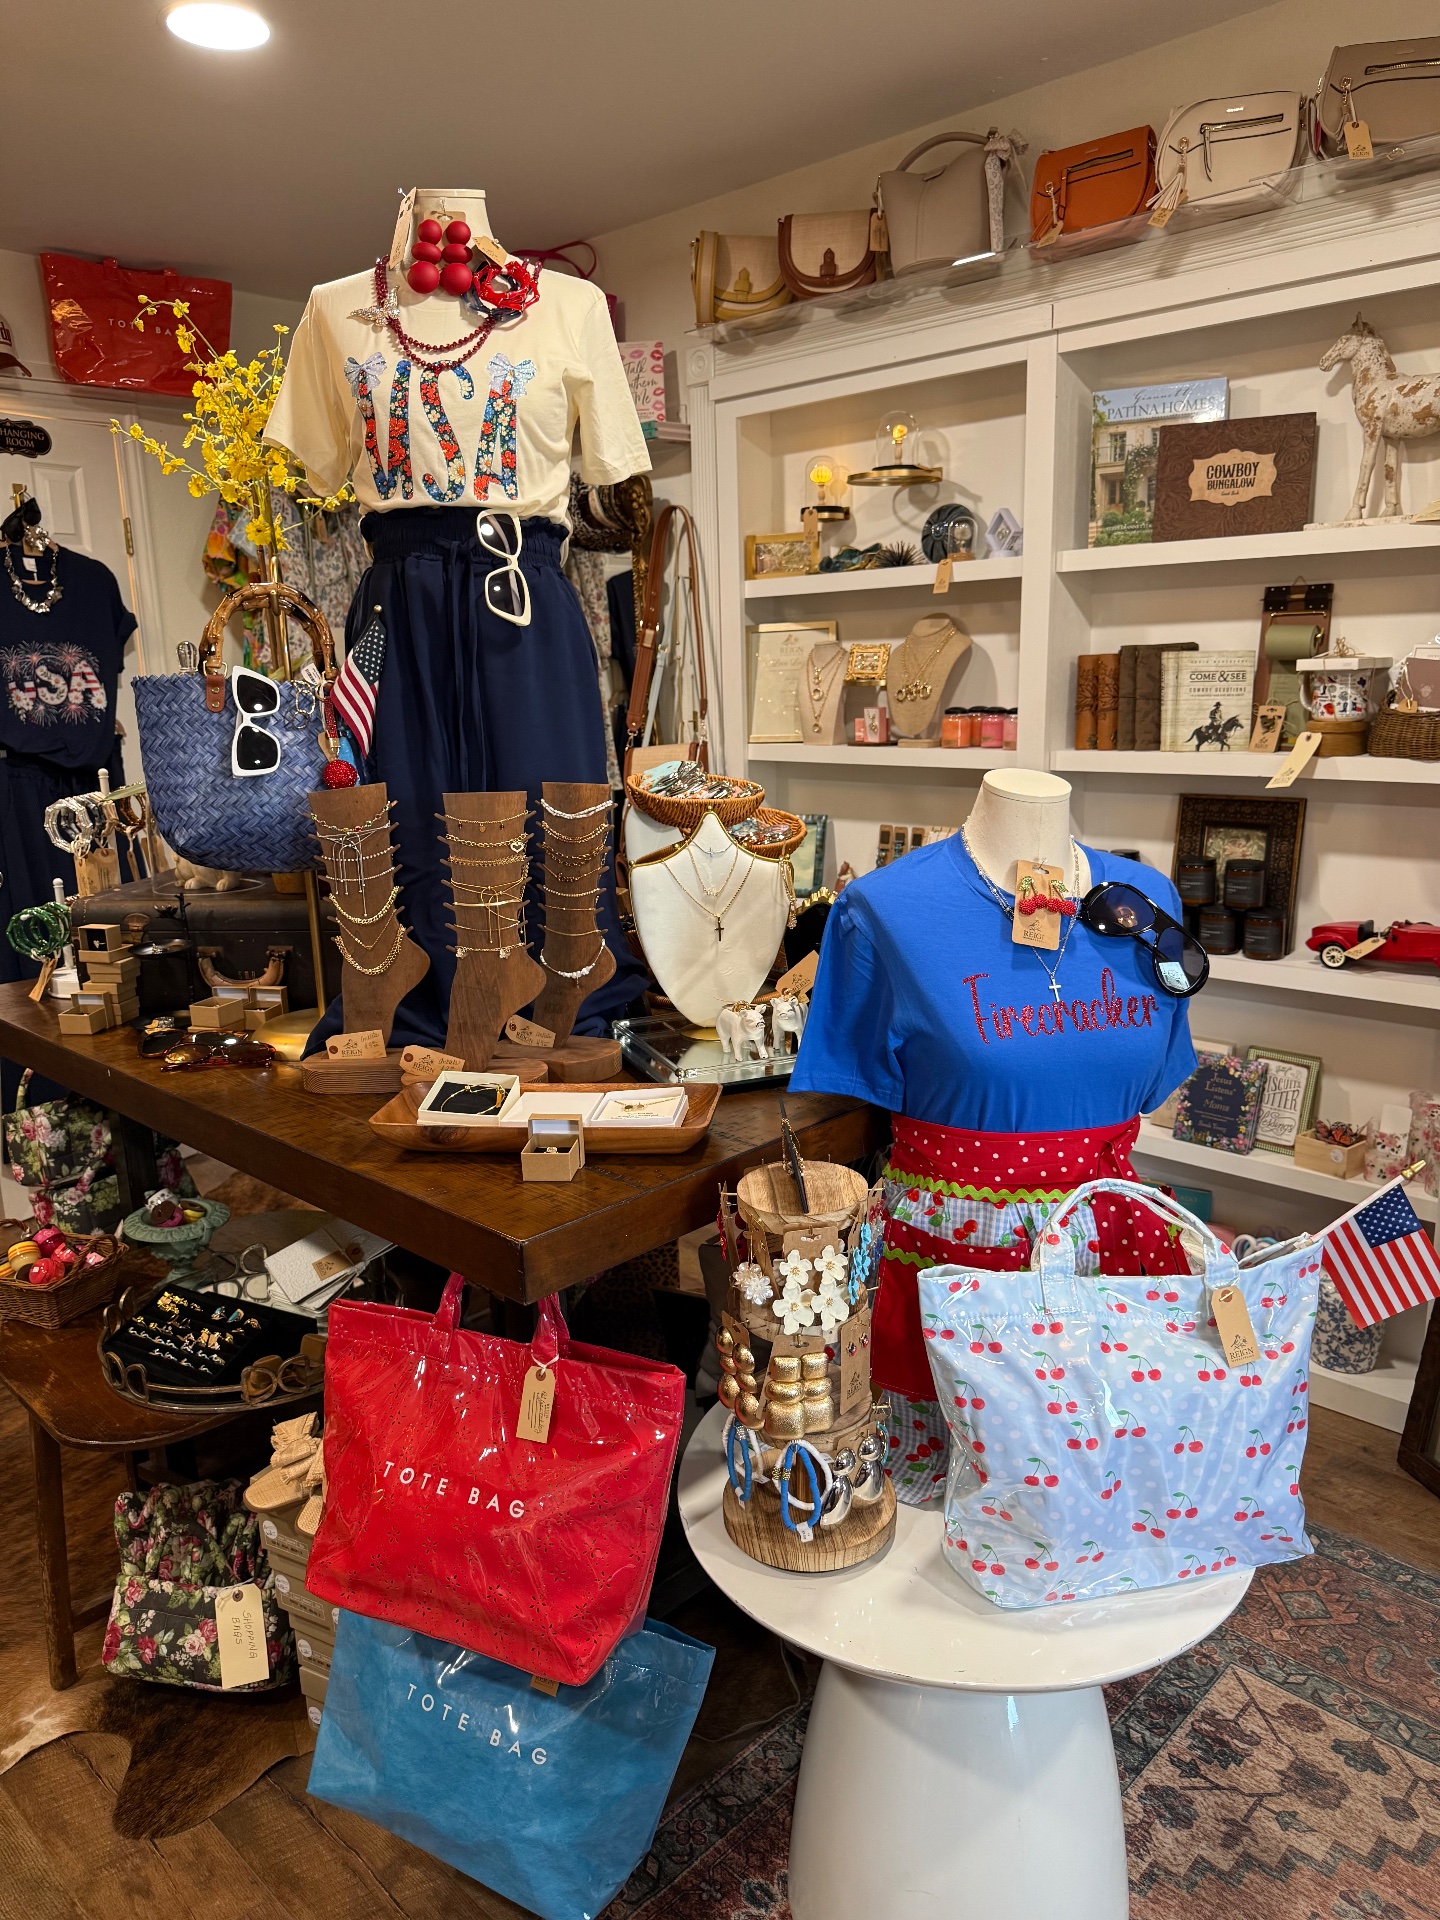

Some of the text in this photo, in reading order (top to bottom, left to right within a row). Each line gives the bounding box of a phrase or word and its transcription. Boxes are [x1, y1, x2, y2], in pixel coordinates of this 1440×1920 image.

[108, 318, 173, 336] TOT BA
[1107, 402, 1159, 420] PATINA
[0, 428, 45, 441] HANGING
[350, 357, 524, 503] USA
[5, 437, 35, 448] ROOM
[1206, 461, 1260, 480] COWBOY
[1207, 477, 1256, 491] BUNGALOW
[7, 659, 108, 712] USA
[1189, 670, 1247, 683] COME & SEE
[962, 967, 1160, 1046] Firecracker
[341, 1048, 363, 1056] REIGN
[413, 1062, 436, 1074] REIGN
[1211, 1072, 1233, 1085] Jesus
[1266, 1074, 1302, 1093] ISCUITS
[1203, 1098, 1230, 1112] Moms
[1263, 1088, 1300, 1112] UTTER
[1229, 1346, 1255, 1360] REIGN
[383, 1460, 526, 1519] TOTE BAG
[231, 1617, 243, 1645] BAGS
[242, 1610, 258, 1659] SHOPPING
[407, 1682, 547, 1766] TOTE BAG
